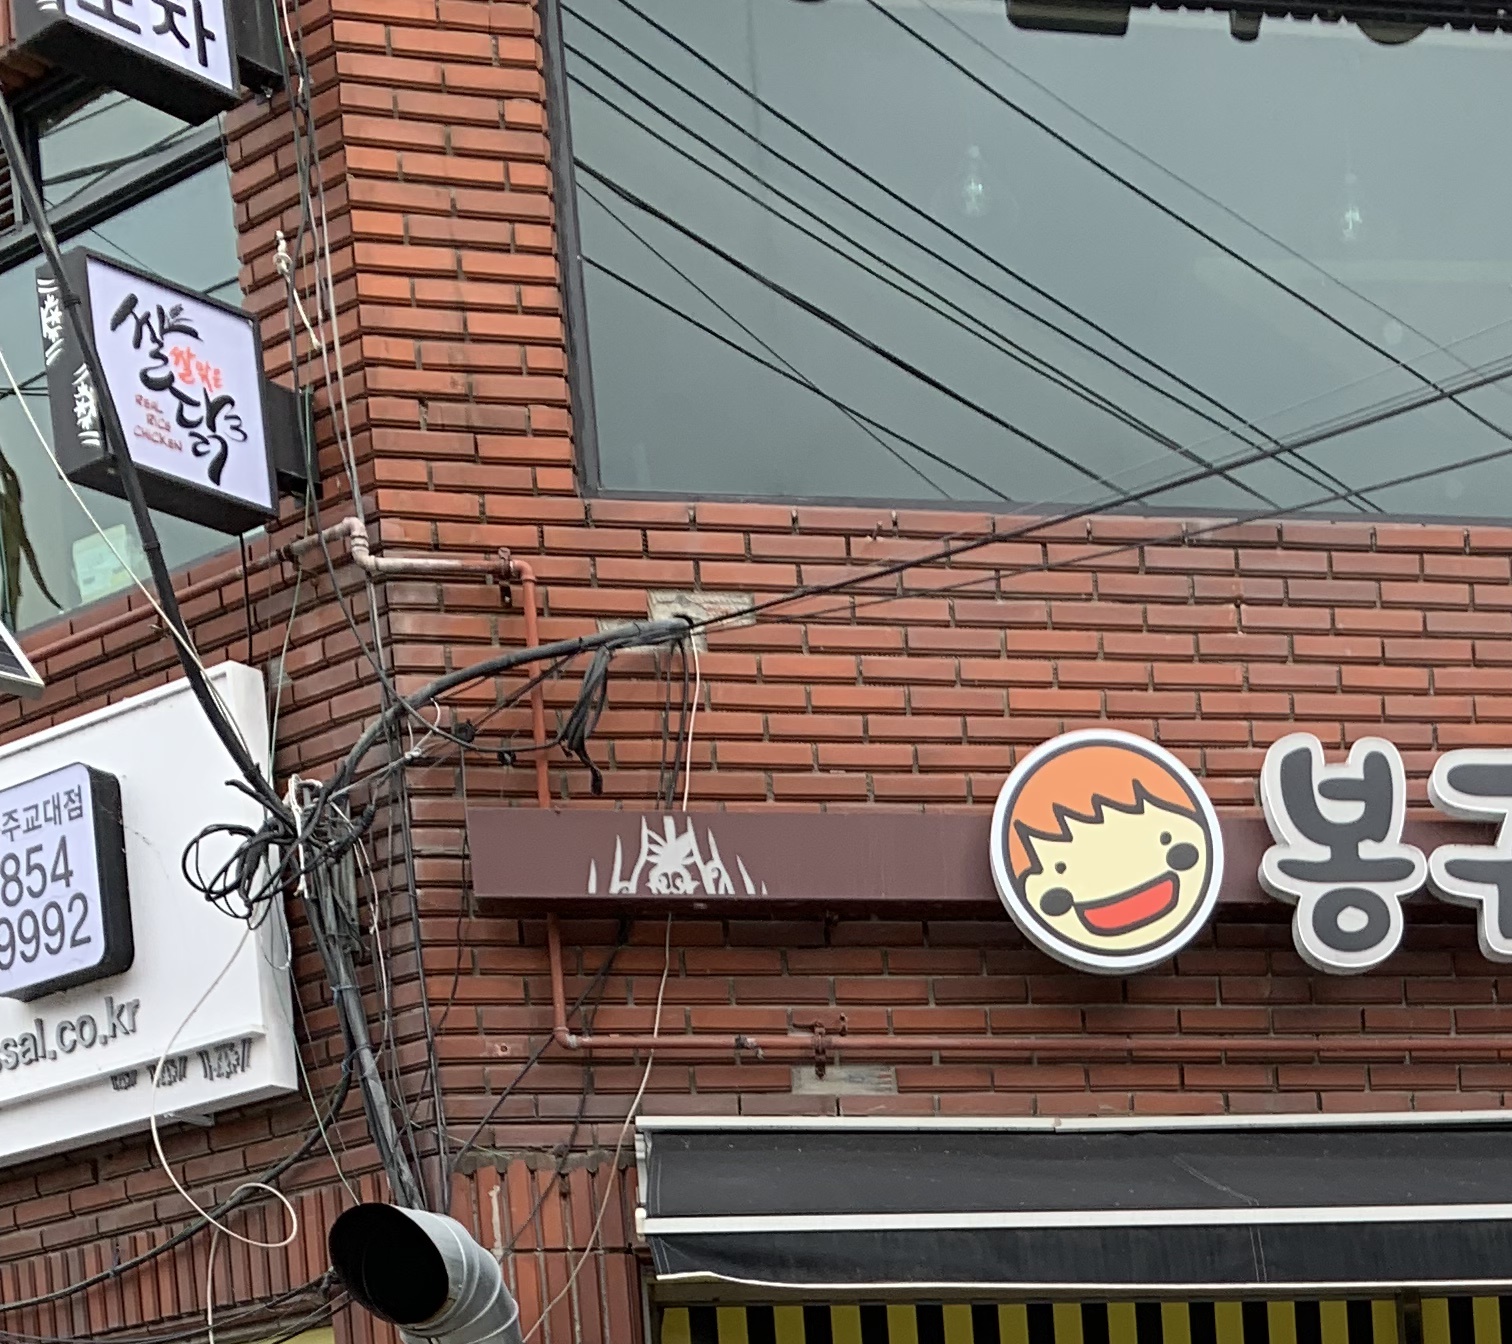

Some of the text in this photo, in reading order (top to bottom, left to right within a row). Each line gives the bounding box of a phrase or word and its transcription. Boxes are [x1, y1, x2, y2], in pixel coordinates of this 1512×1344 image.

[1, 834, 74, 907] 854
[0, 892, 92, 970] 9992
[0, 995, 140, 1074] sal.co.kr
